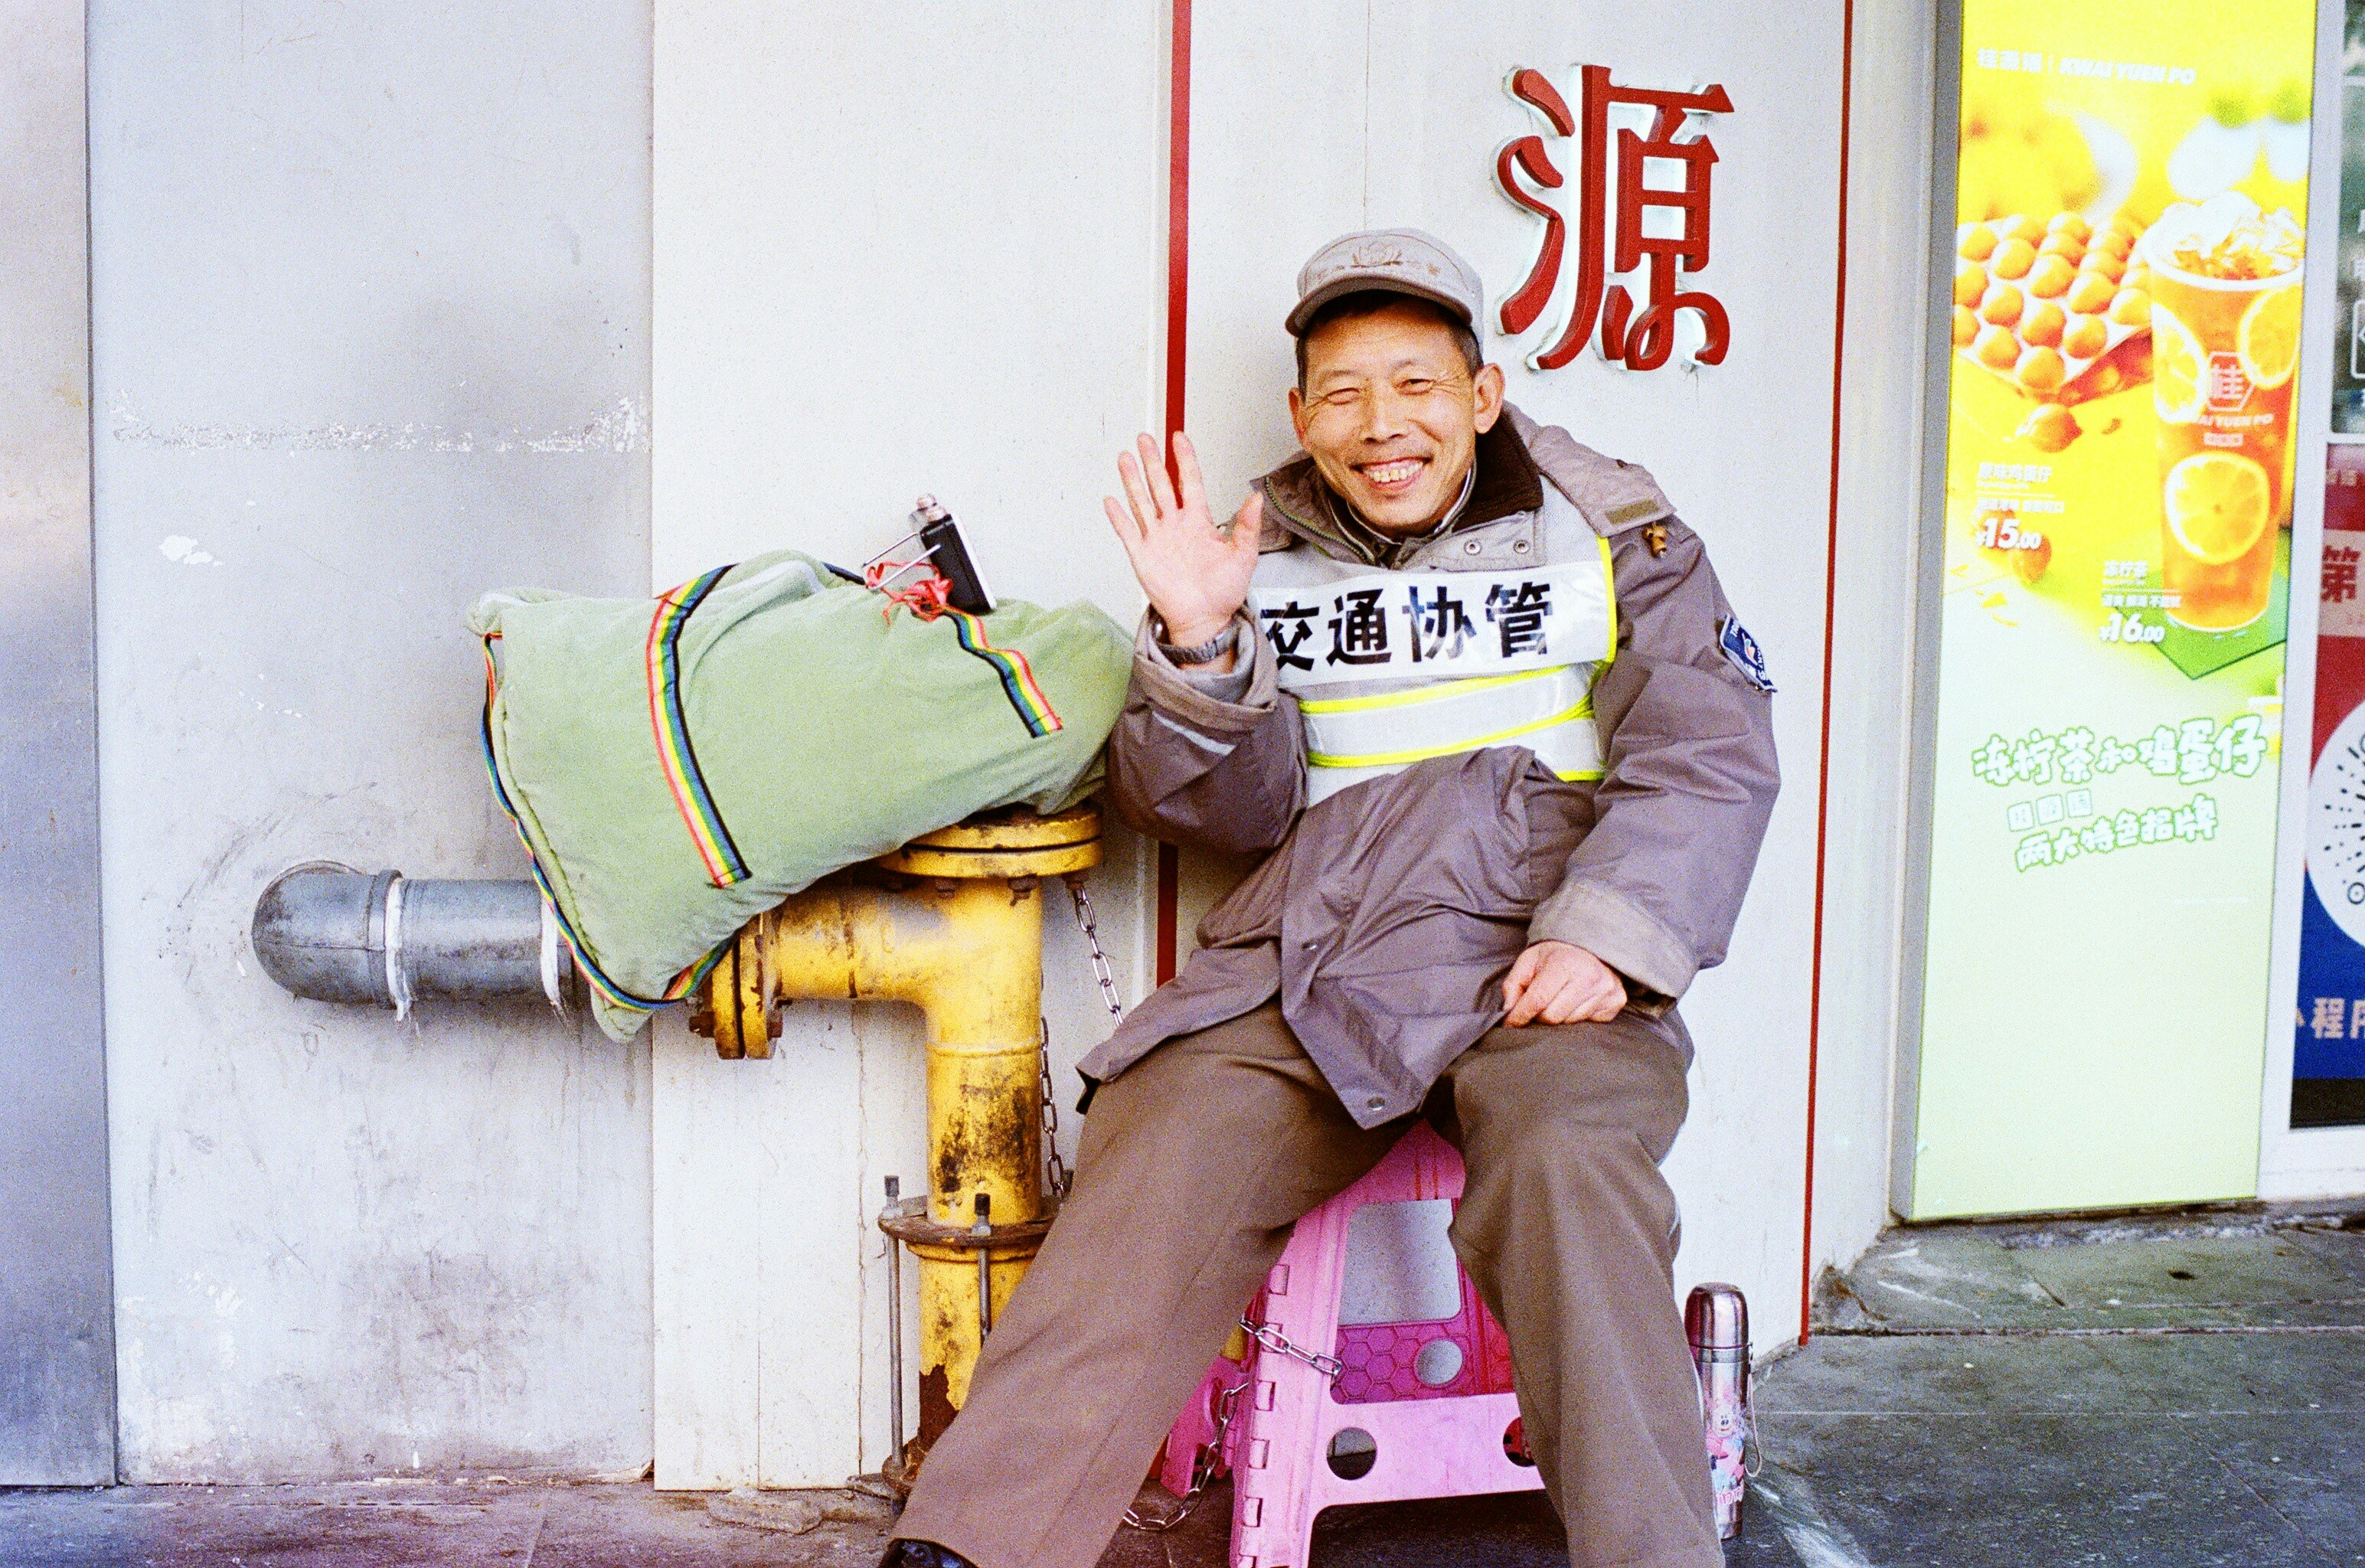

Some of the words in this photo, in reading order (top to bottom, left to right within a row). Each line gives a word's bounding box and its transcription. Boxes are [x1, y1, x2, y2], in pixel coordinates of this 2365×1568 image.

[1497, 64, 1735, 371] 源
[1260, 582, 1553, 671] 交通协管
[1972, 714, 2268, 786] 冻柠茶和鸡蛋仔
